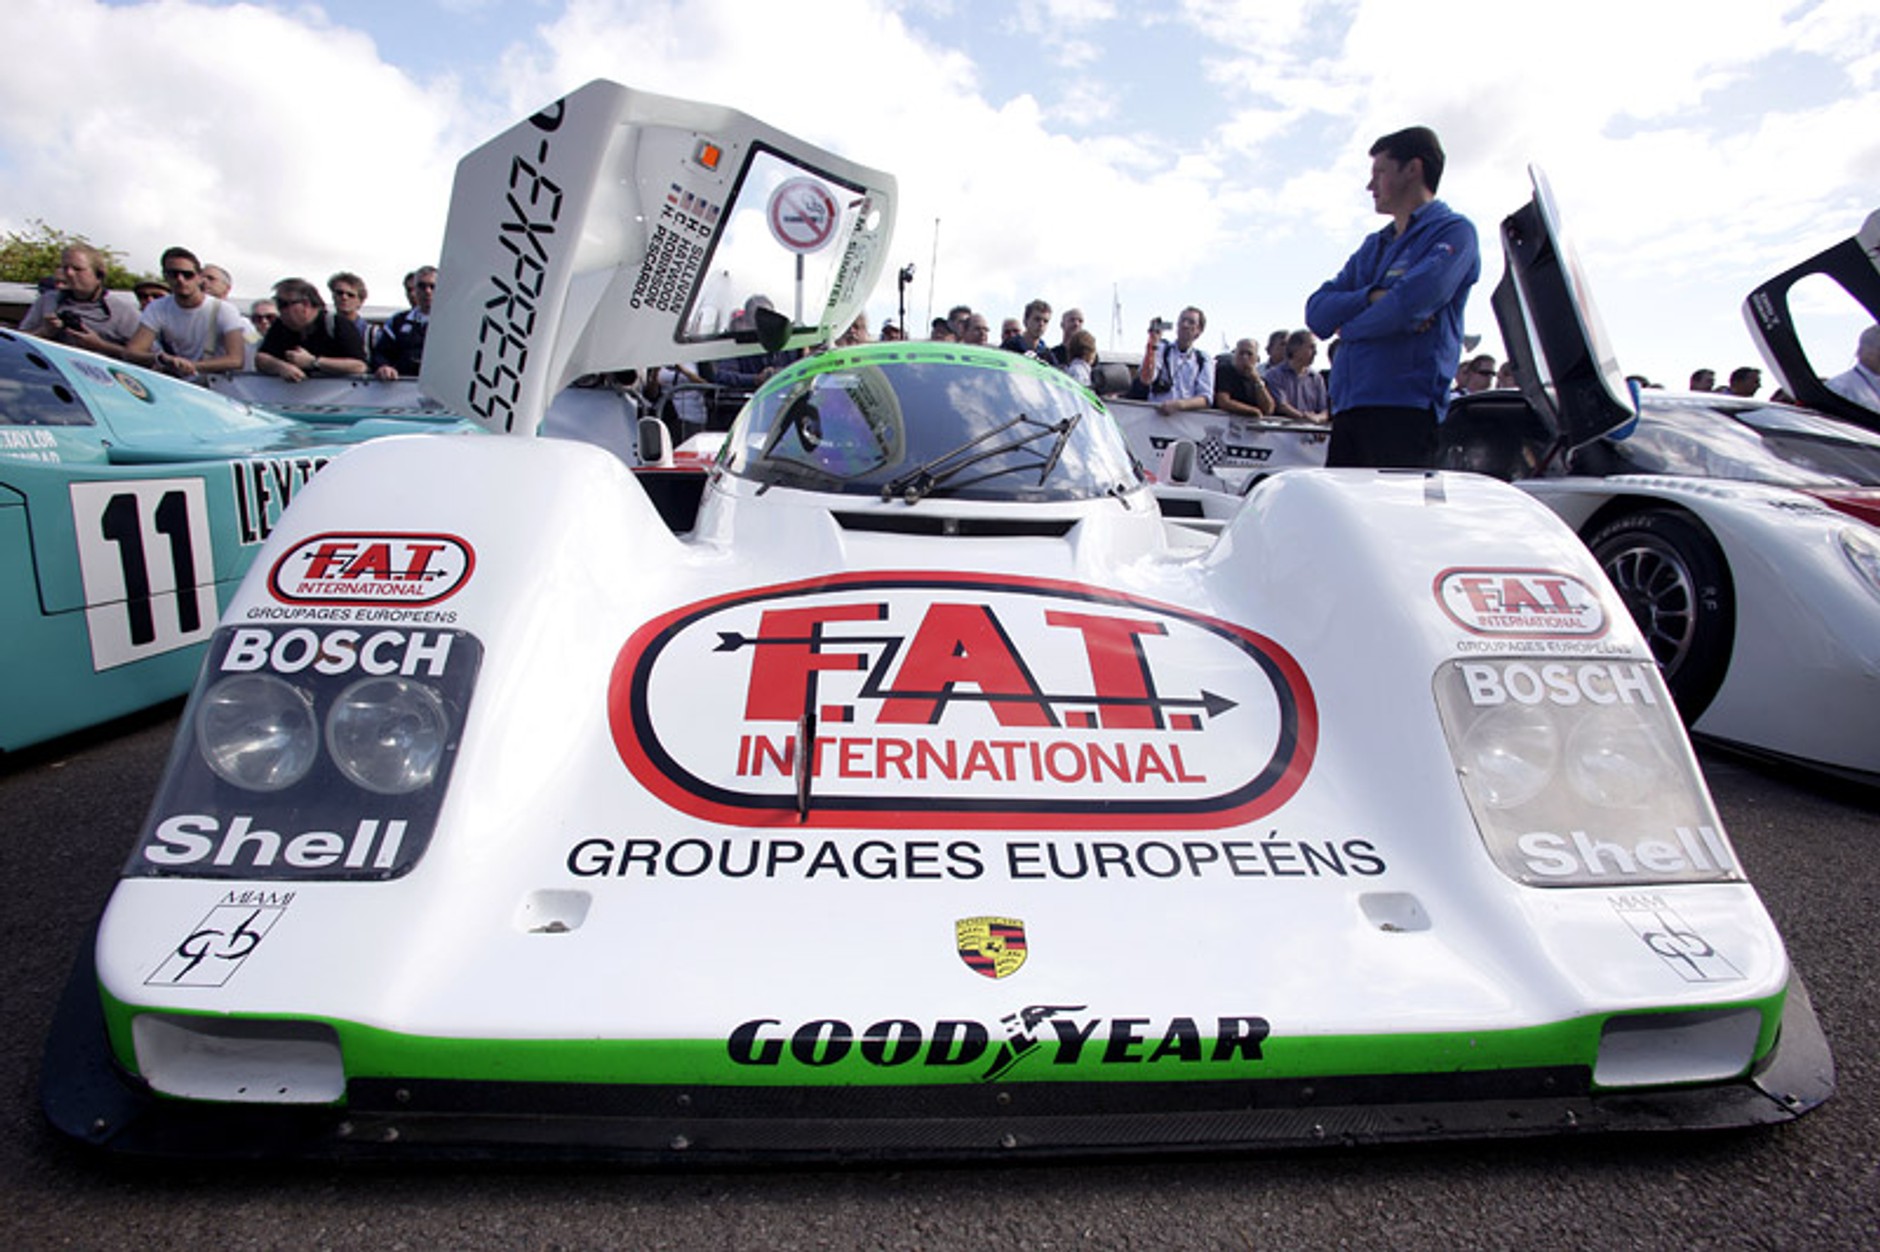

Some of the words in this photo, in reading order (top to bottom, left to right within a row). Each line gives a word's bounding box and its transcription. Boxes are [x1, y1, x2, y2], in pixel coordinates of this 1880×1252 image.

[630, 223, 666, 309] PESCAROLO
[644, 230, 680, 308] ROBINSON
[656, 238, 692, 311] HAYWOOD
[670, 244, 704, 314] SULLIVAN
[231, 458, 330, 544] LEYT
[101, 491, 200, 646] 11
[303, 543, 446, 582] F.A.T.
[246, 606, 351, 621] GROUPAGES
[296, 582, 425, 596] INTERNATIONAL
[1478, 615, 1588, 629] INTERNATIONAL
[221, 629, 453, 676] BOSCH
[744, 601, 1204, 731] F.A.T.
[1461, 662, 1657, 707] BOSCH
[736, 735, 1206, 785] INTERNATIONAL
[144, 815, 407, 868] Shell
[567, 838, 985, 879] GROUPAGES
[1008, 829, 1386, 880] EUROPEÉNS
[1516, 826, 1733, 877] Shell
